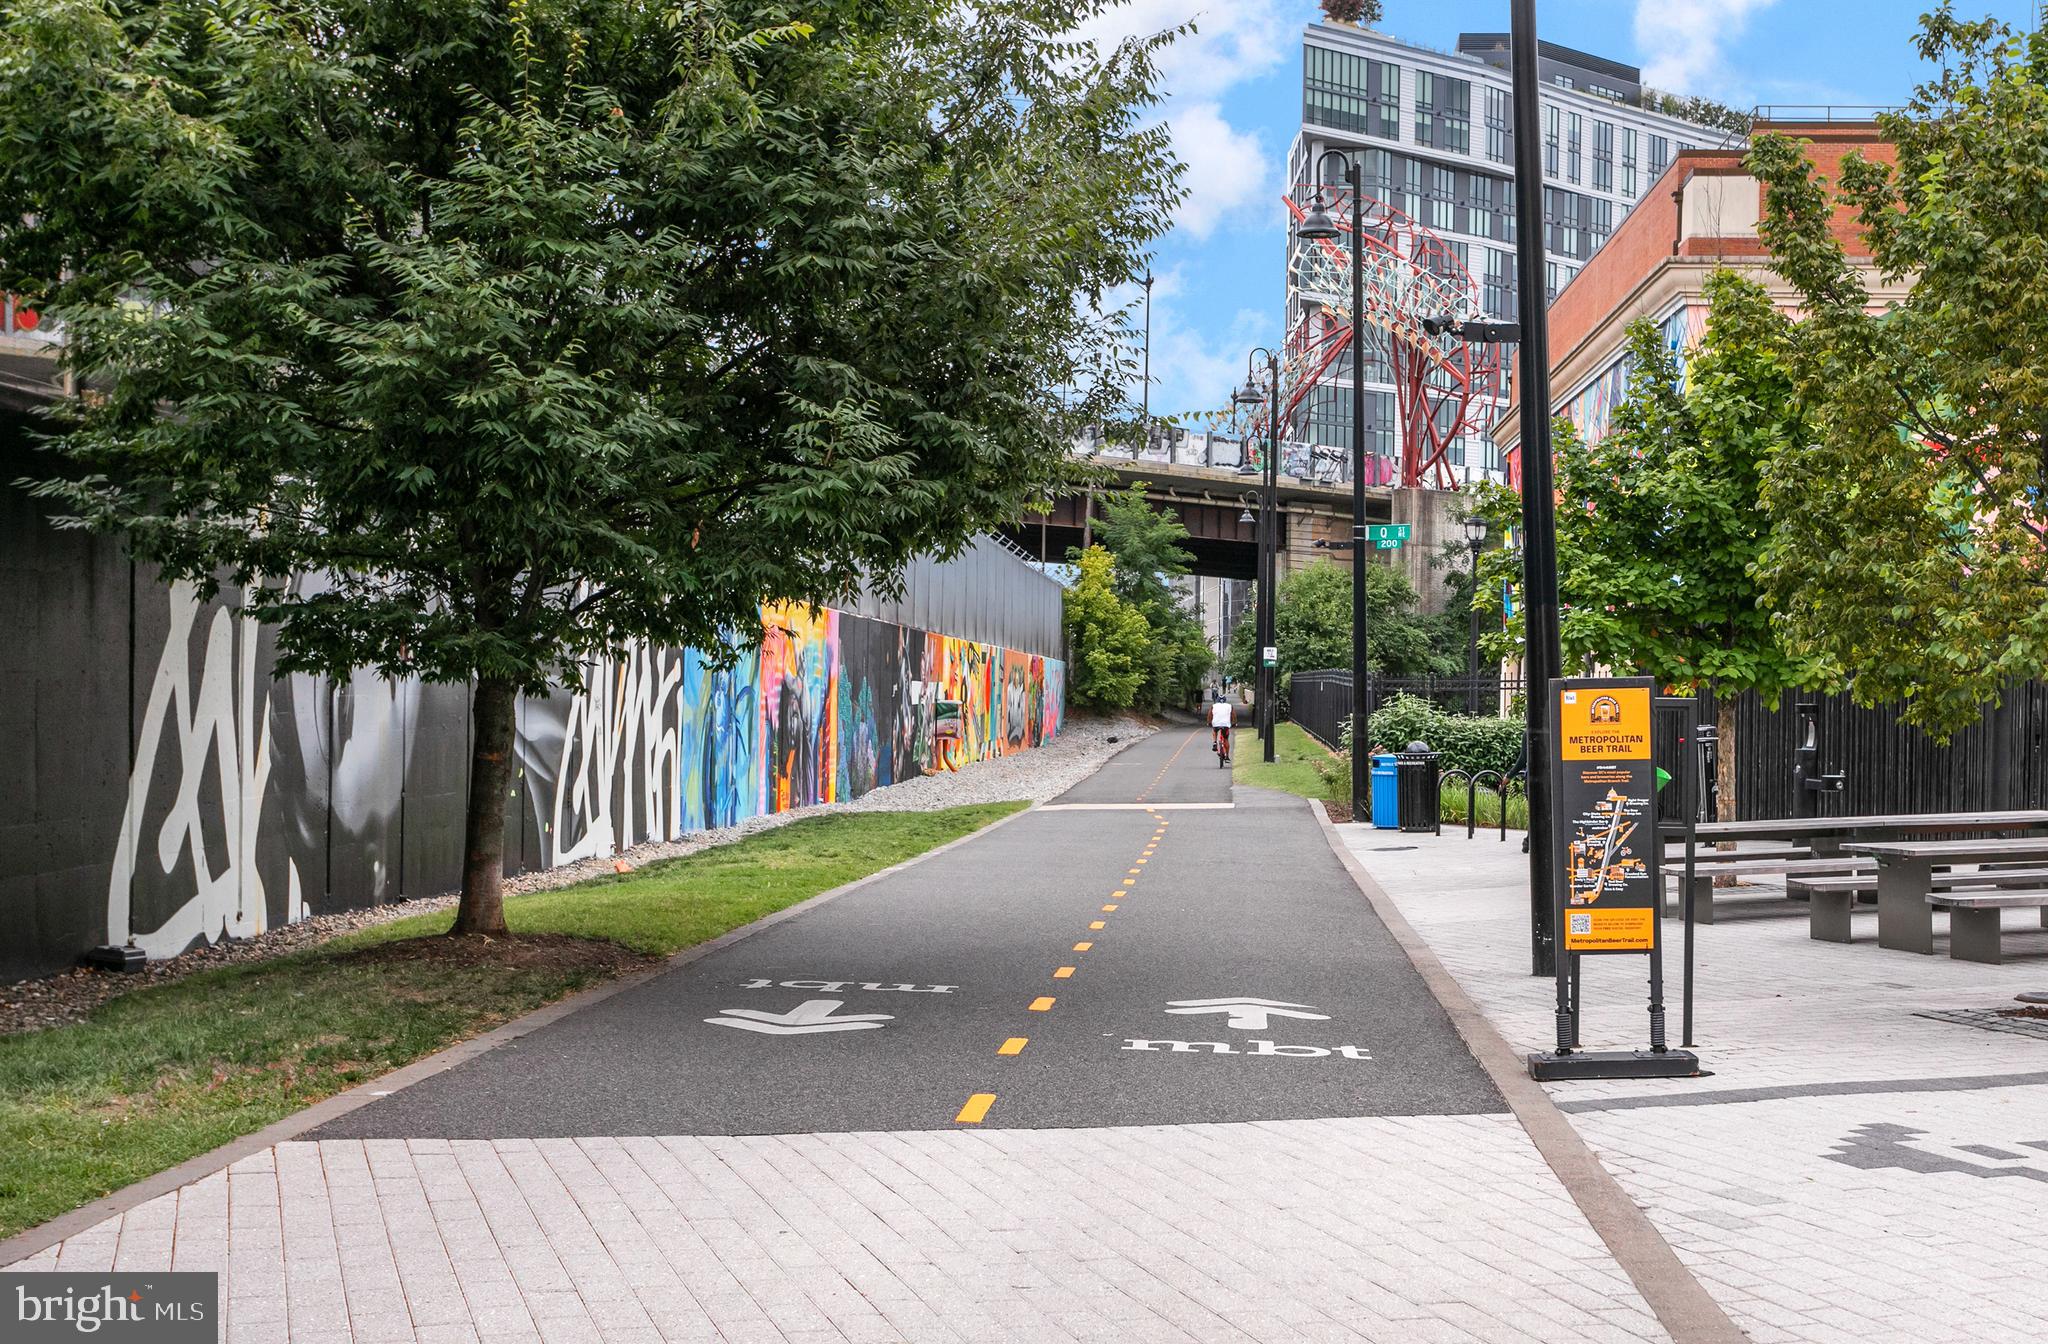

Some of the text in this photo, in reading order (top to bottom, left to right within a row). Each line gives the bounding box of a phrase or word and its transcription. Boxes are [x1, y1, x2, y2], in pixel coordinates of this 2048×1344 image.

[1380, 527, 1387, 538] Q
[1569, 735, 1643, 744] METROPOLITAN
[1580, 745, 1604, 753] BEER
[1121, 1039, 1372, 1060] mbt
